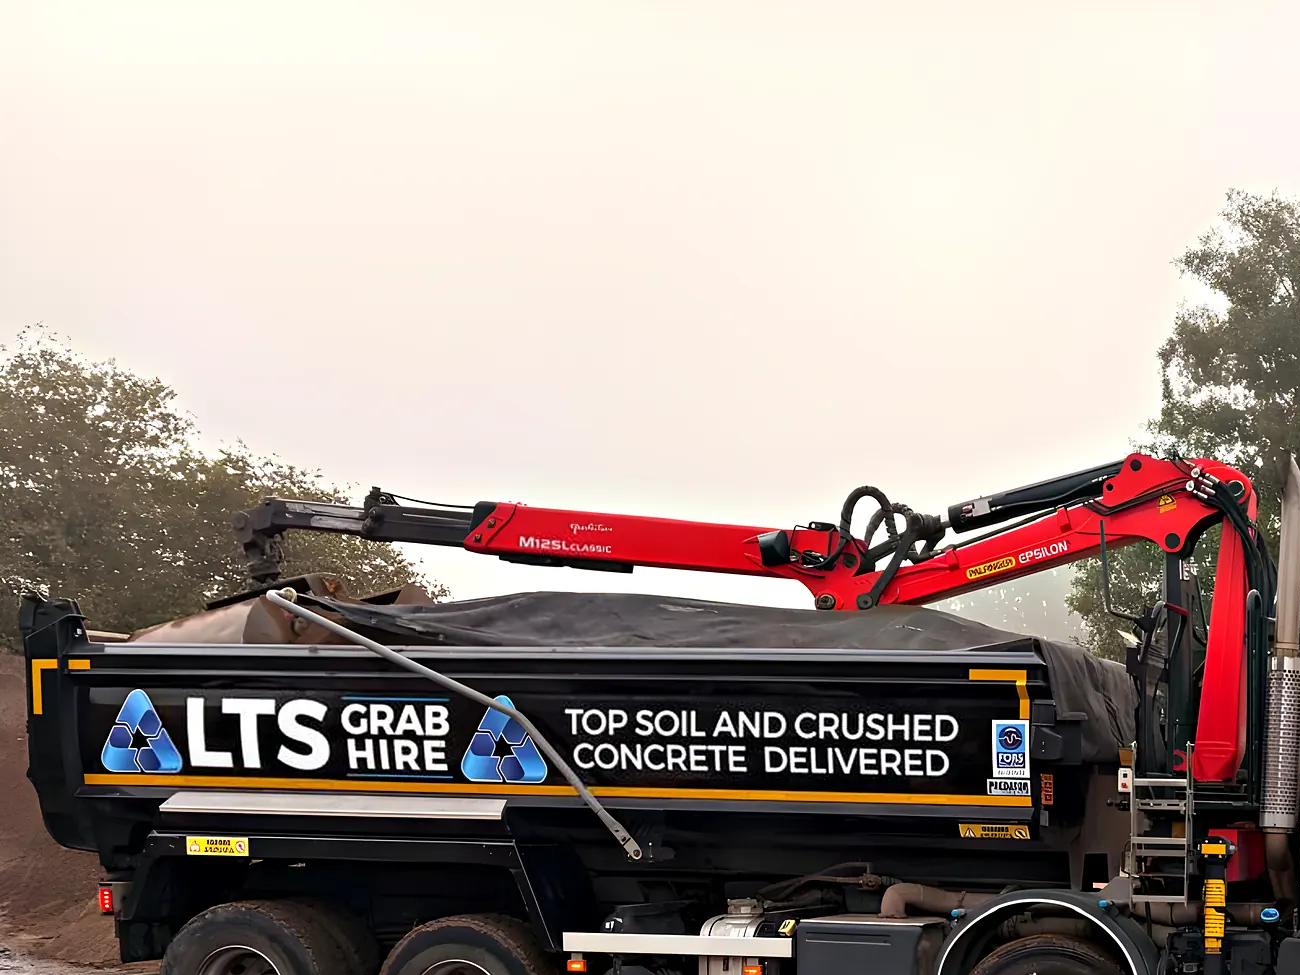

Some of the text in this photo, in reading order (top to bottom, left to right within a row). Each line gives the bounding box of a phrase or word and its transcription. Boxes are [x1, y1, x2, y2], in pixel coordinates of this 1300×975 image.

[1018, 540, 1068, 564] EPSILON
[186, 696, 331, 771] LTS
[340, 703, 450, 737] GRAB
[564, 708, 959, 742] TOP SOIL AND CRUSHED
[346, 738, 449, 771] HIRE
[573, 742, 950, 777] CONCRETE DELIVERED
